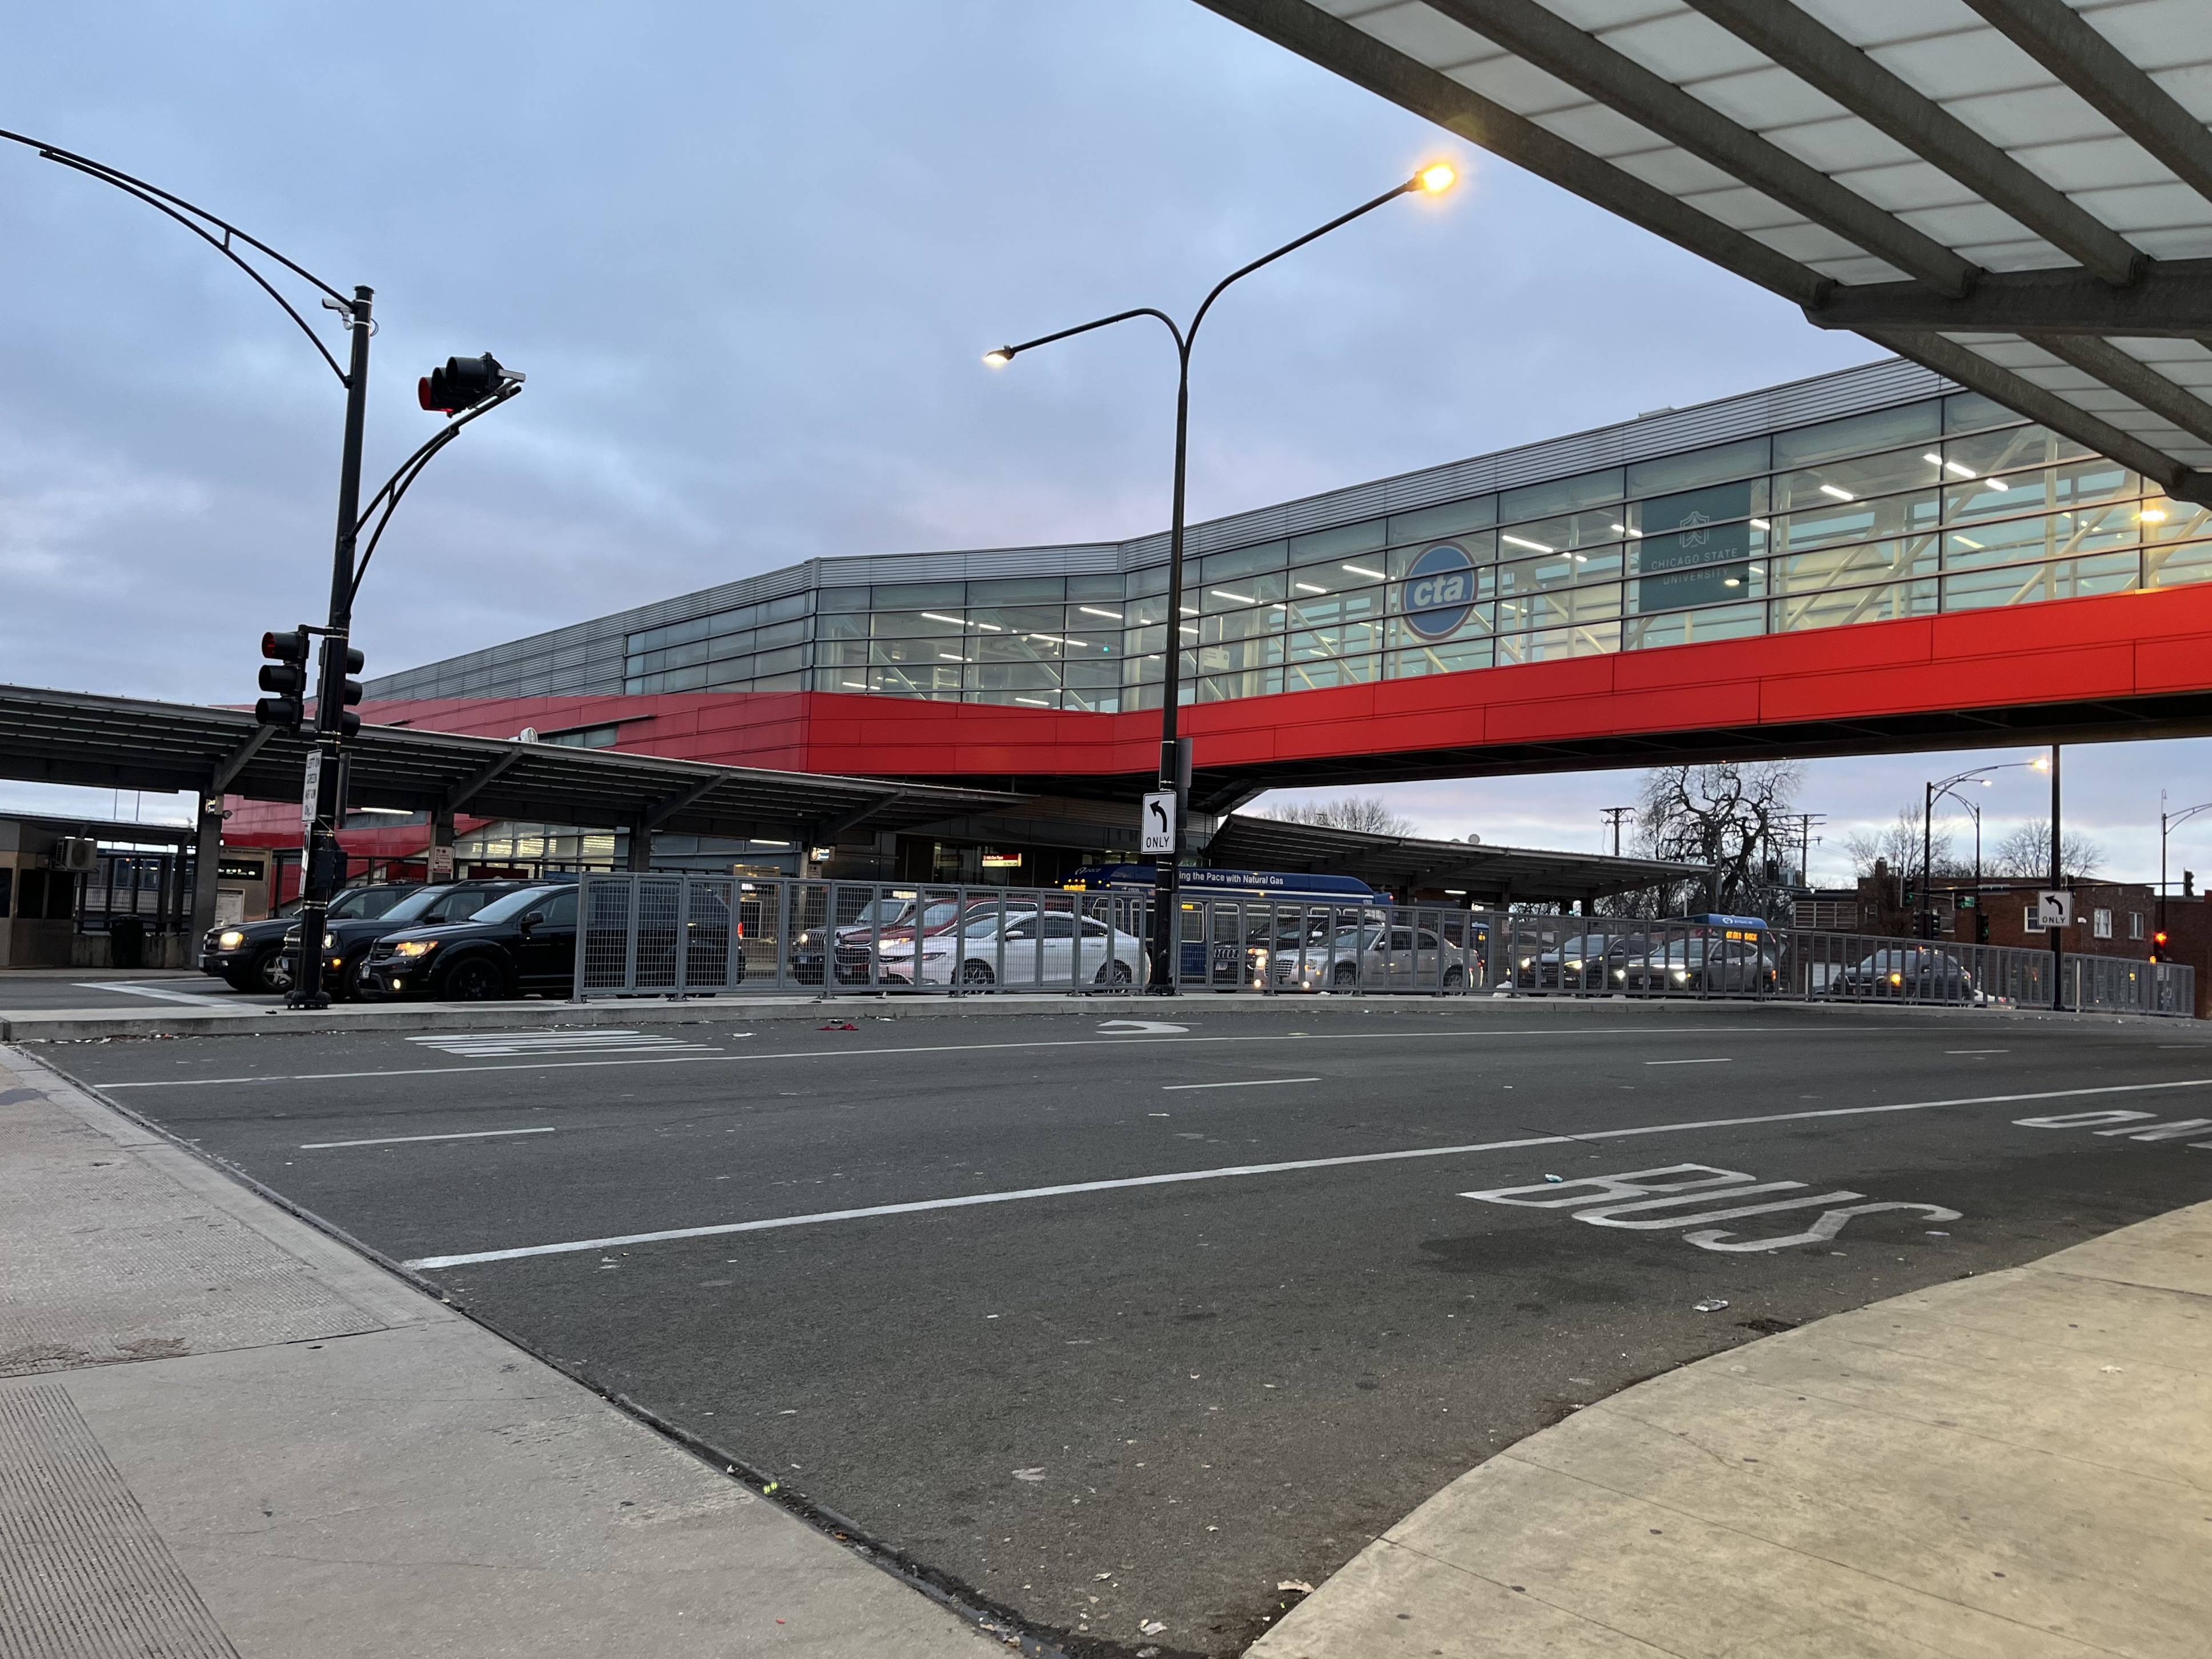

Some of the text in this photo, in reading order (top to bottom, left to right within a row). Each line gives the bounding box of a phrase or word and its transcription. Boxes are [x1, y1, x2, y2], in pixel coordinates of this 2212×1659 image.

[1651, 548, 1738, 570] CHICAGO STATE
[1663, 568, 1728, 585] UNIVERSITY
[1414, 575, 1464, 607] cta
[1146, 836, 1169, 848] ONLY
[1193, 872, 1205, 880] the
[1207, 872, 1225, 881] Pace
[1227, 873, 1241, 883] with
[1243, 875, 1268, 884] Natural
[1269, 876, 1284, 885] Gas
[1456, 1163, 1964, 1252] BUS
